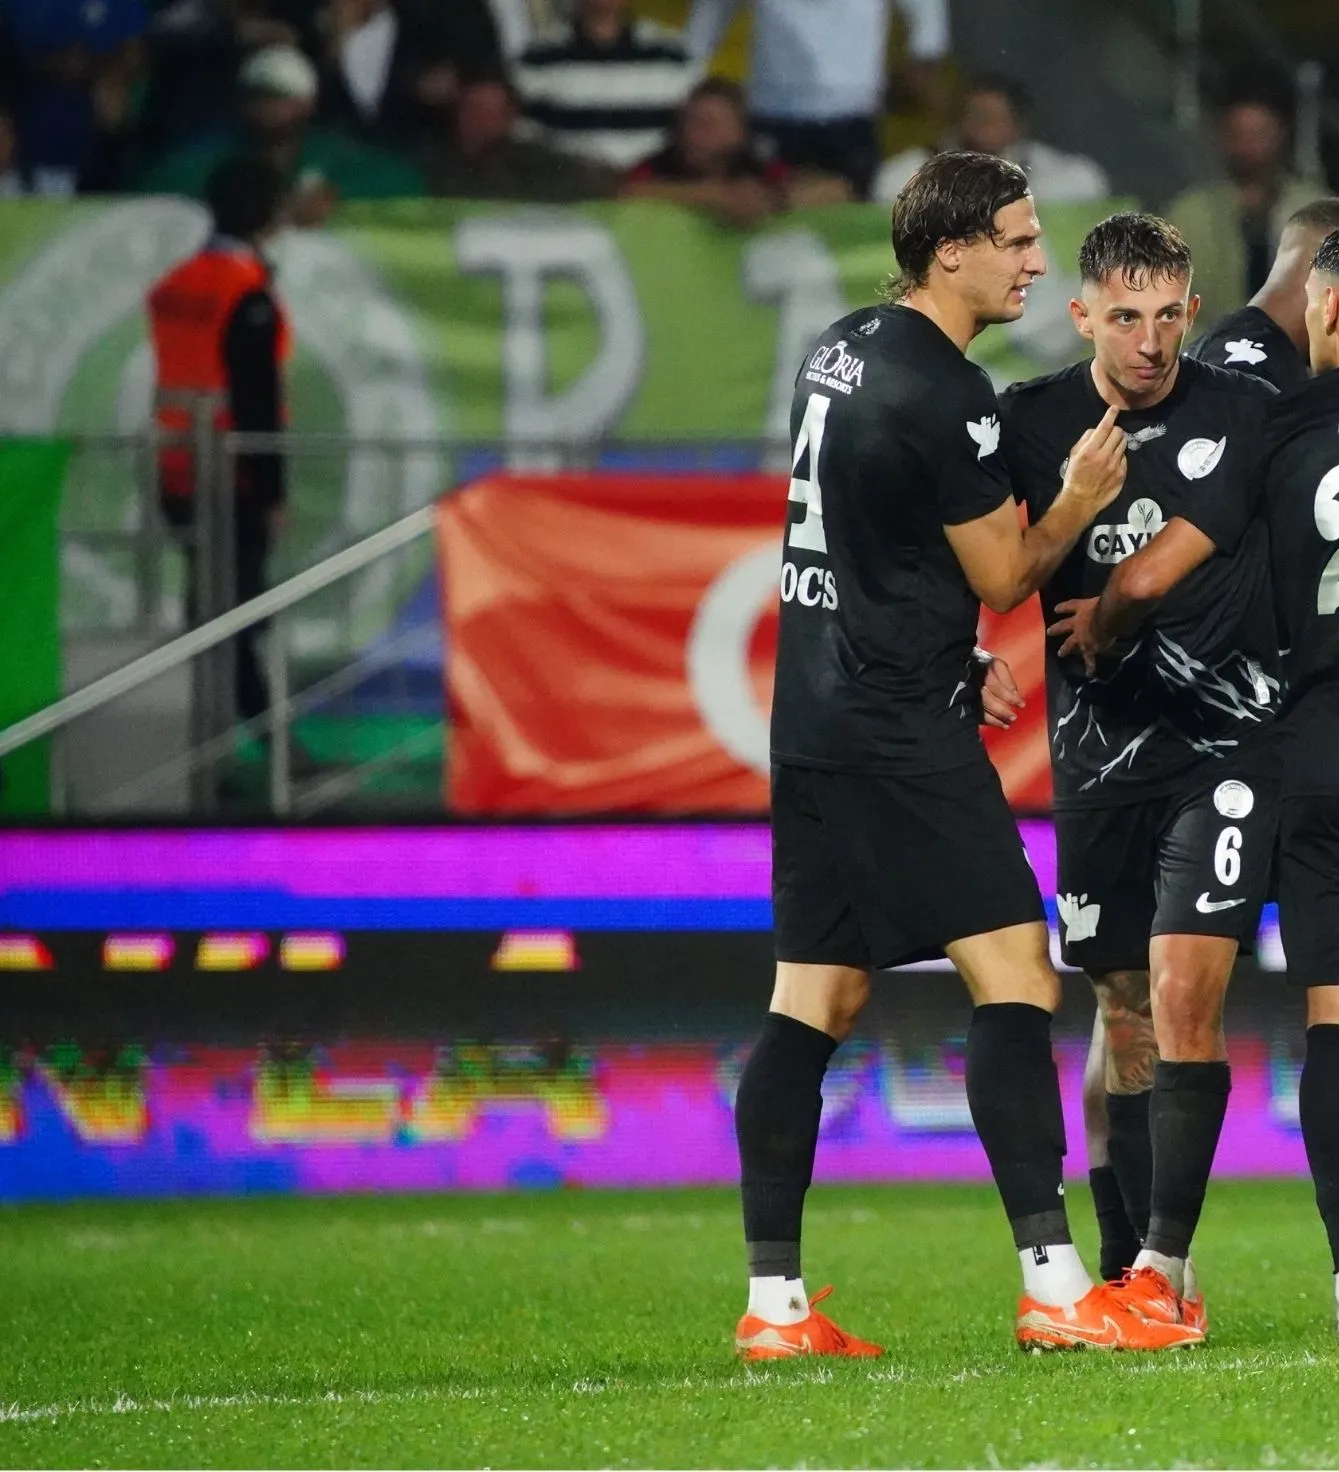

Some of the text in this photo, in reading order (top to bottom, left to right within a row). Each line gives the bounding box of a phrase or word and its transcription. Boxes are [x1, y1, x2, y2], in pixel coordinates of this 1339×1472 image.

[809, 344, 865, 387] GLORIA
[788, 393, 831, 555] 4
[1214, 826, 1243, 886] 6
